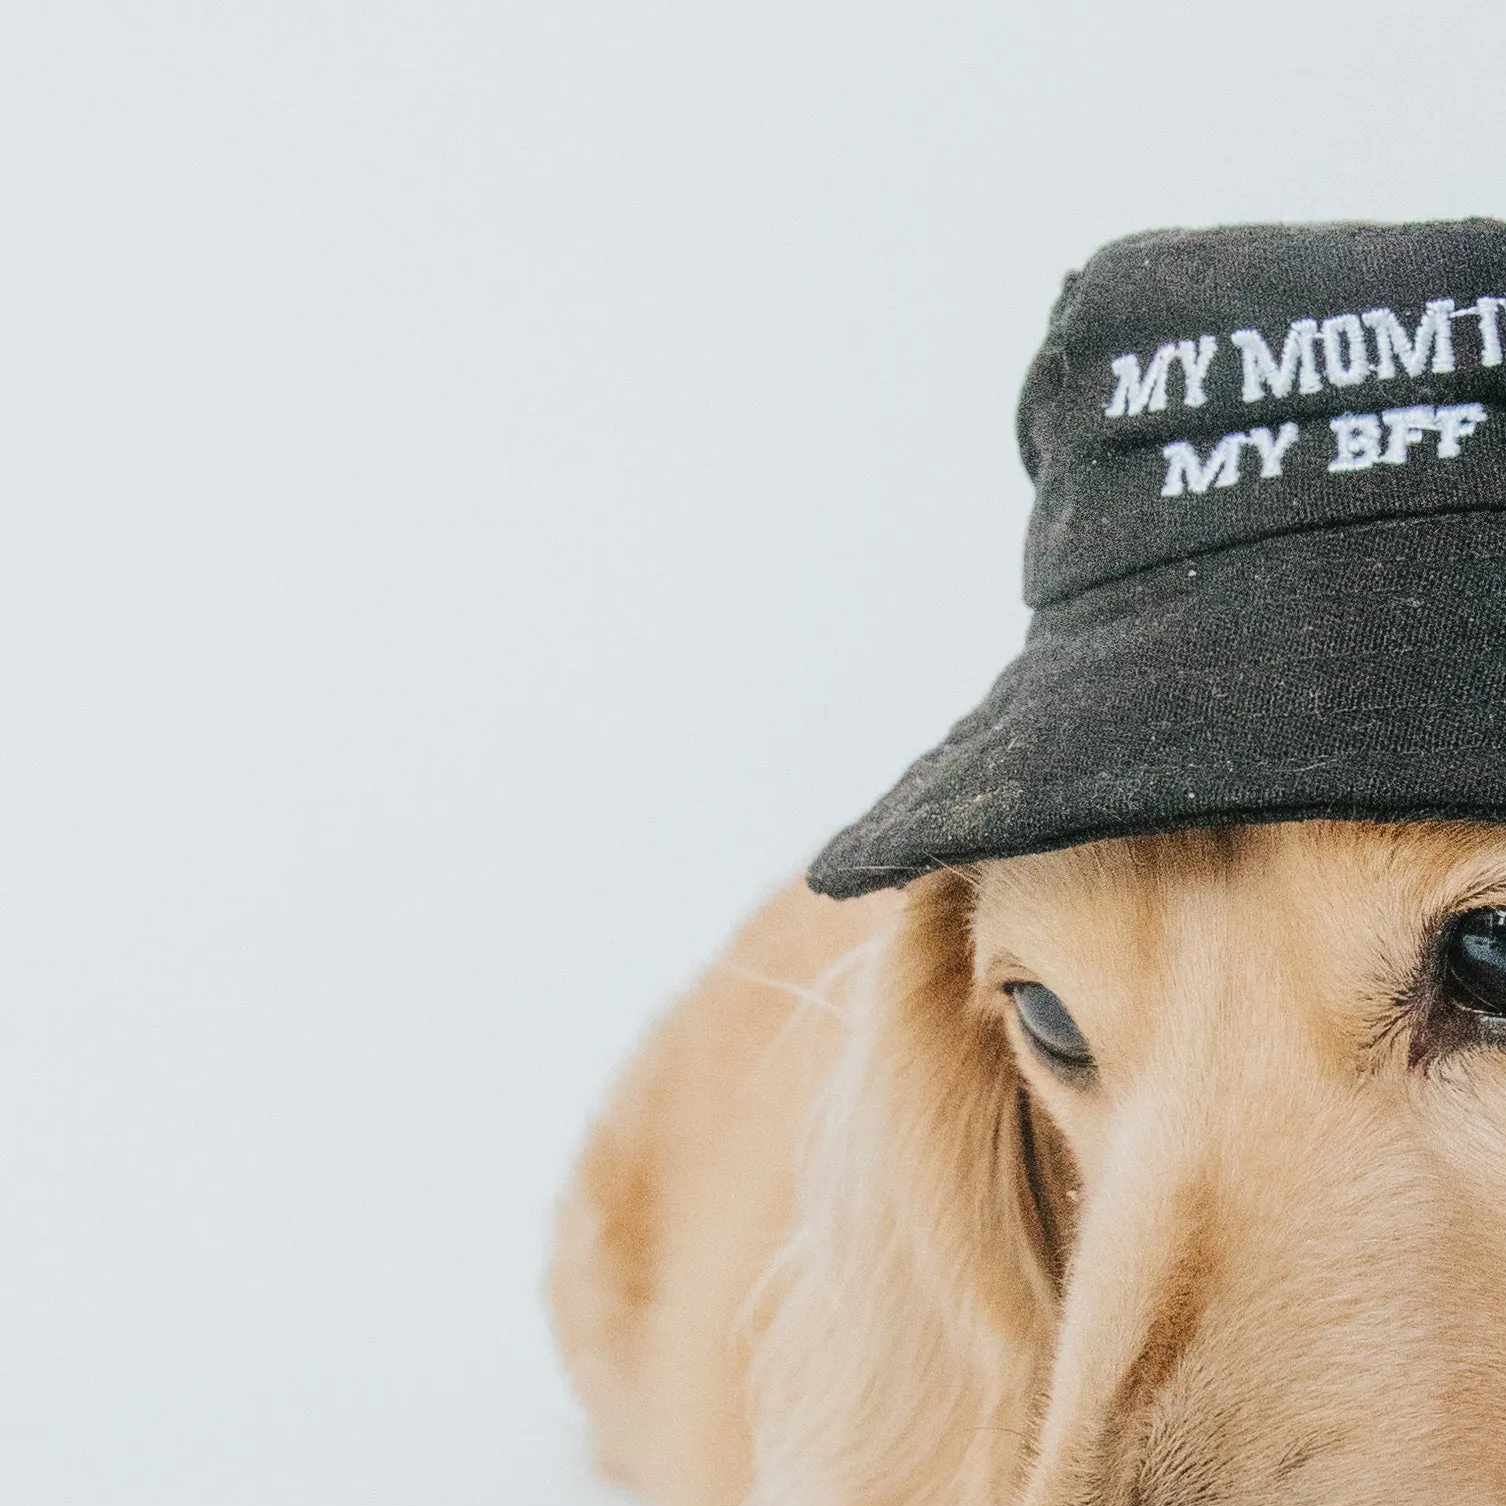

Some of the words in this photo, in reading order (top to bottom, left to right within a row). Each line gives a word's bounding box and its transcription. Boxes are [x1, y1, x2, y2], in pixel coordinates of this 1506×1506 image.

[1104, 335, 1217, 417] MY
[1231, 299, 1455, 402] MOM
[1160, 422, 1299, 497] MY
[1328, 402, 1487, 473] BFF
